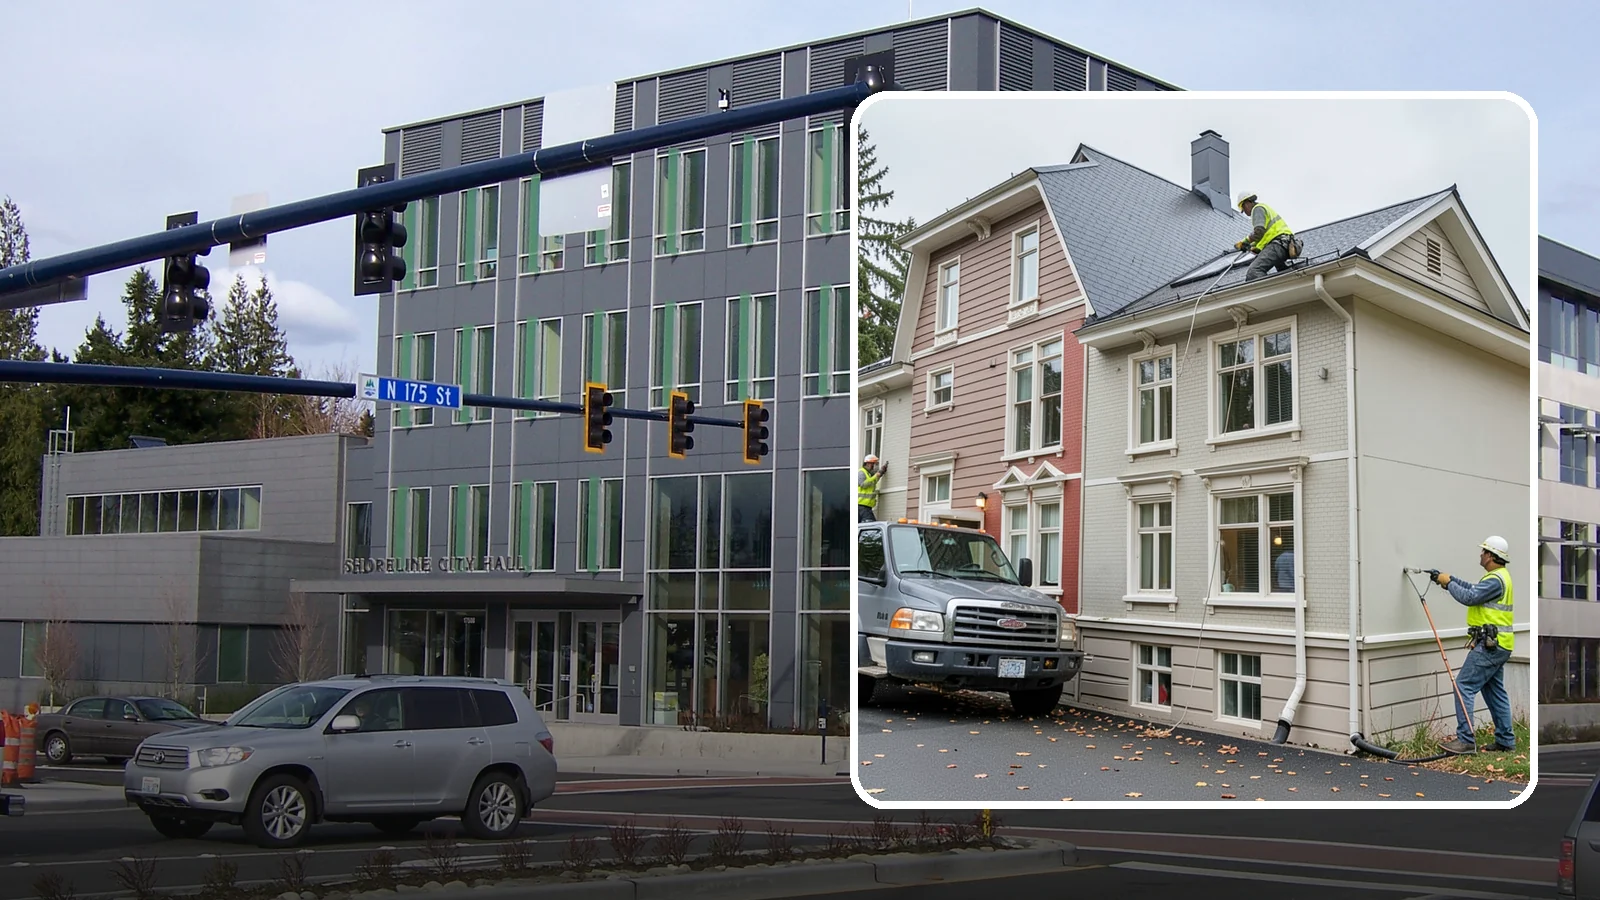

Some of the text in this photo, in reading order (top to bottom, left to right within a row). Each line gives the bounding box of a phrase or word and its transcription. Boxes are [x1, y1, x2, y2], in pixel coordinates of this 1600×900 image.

[387, 380, 451, 406] N 175 St
[344, 555, 525, 574] SHORELINE CITY HALL
